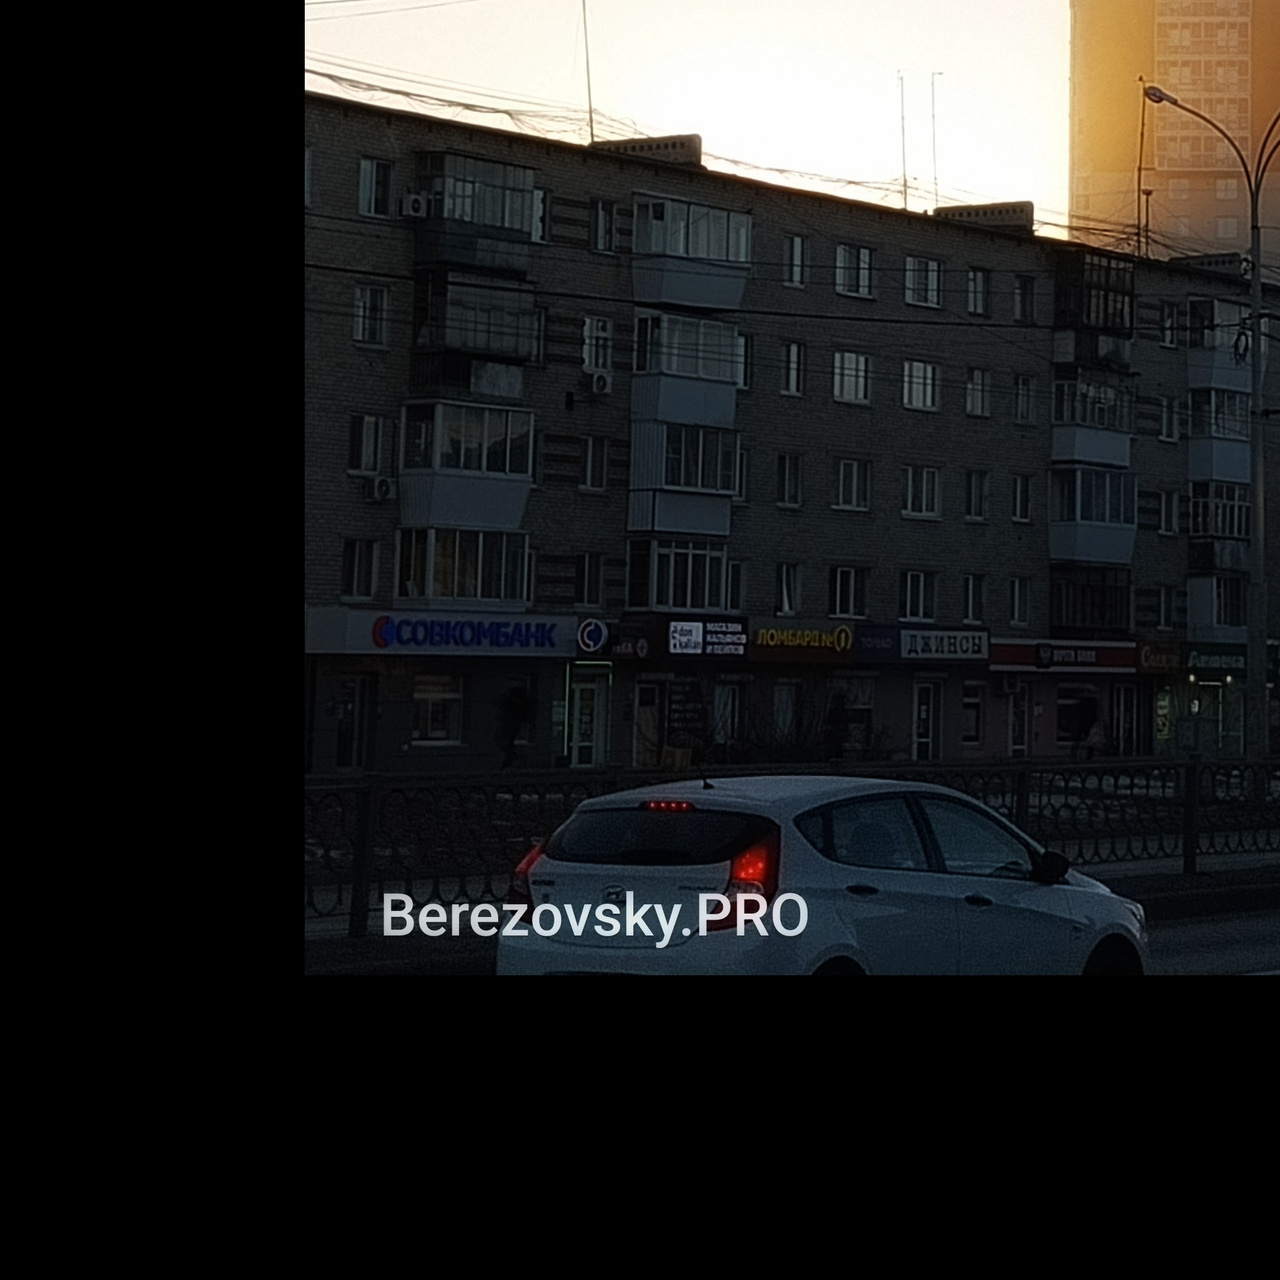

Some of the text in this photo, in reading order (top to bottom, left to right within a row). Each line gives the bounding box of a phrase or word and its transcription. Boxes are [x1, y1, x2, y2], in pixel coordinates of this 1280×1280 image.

[395, 618, 558, 649] СОВКОМБАНК
[756, 628, 820, 647] ЛОМБАРД
[907, 634, 982, 656] ДЖИНСЫ
